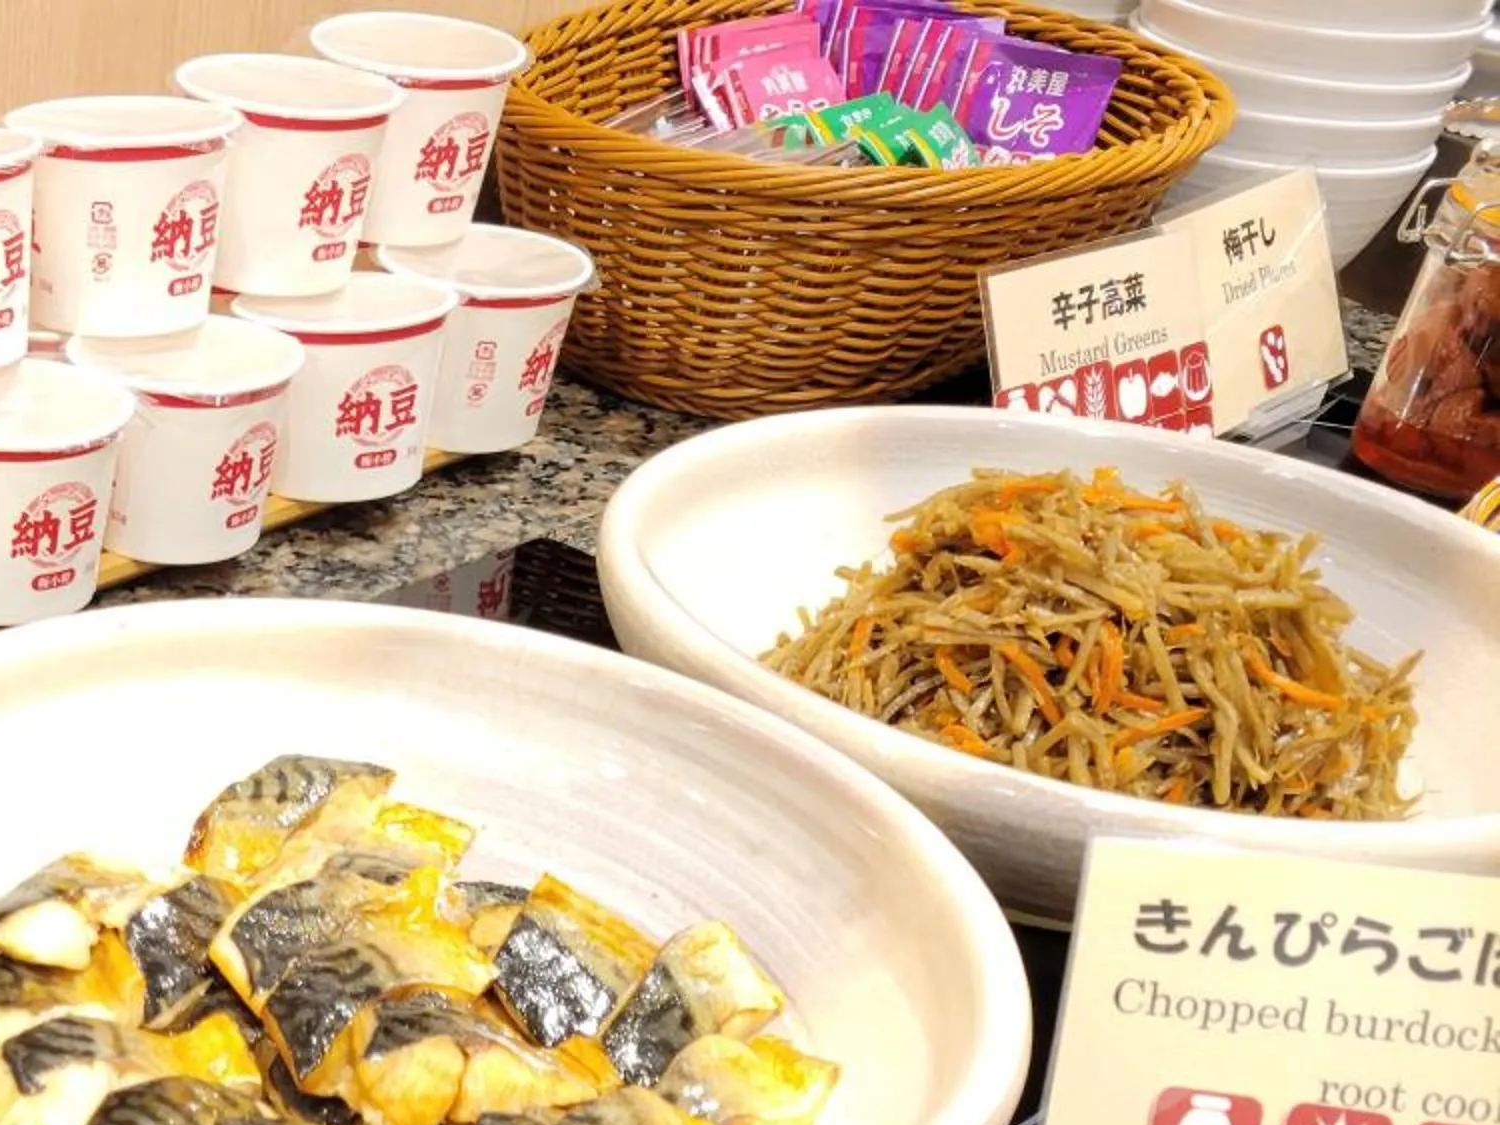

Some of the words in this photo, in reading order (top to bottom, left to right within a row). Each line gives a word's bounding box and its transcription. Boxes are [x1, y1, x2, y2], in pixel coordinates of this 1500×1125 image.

[988, 97, 1065, 148] しそ
[414, 131, 490, 181] 納豆
[298, 175, 371, 228] 納豆
[150, 201, 219, 263] 納豆
[1222, 216, 1276, 266] 梅干し
[1051, 272, 1147, 331] 辛子高菜
[1221, 271, 1257, 304] Dried
[1040, 336, 1110, 377] Mustard
[1114, 326, 1169, 357] Greens
[336, 384, 418, 438] 納豆
[211, 439, 276, 500] 納豆
[10, 499, 98, 559] 納豆
[1112, 977, 1309, 1034] Chopped
[1326, 998, 1500, 1054] burdock
[1319, 1078, 1407, 1114] root
[1421, 1086, 1500, 1124] coo
